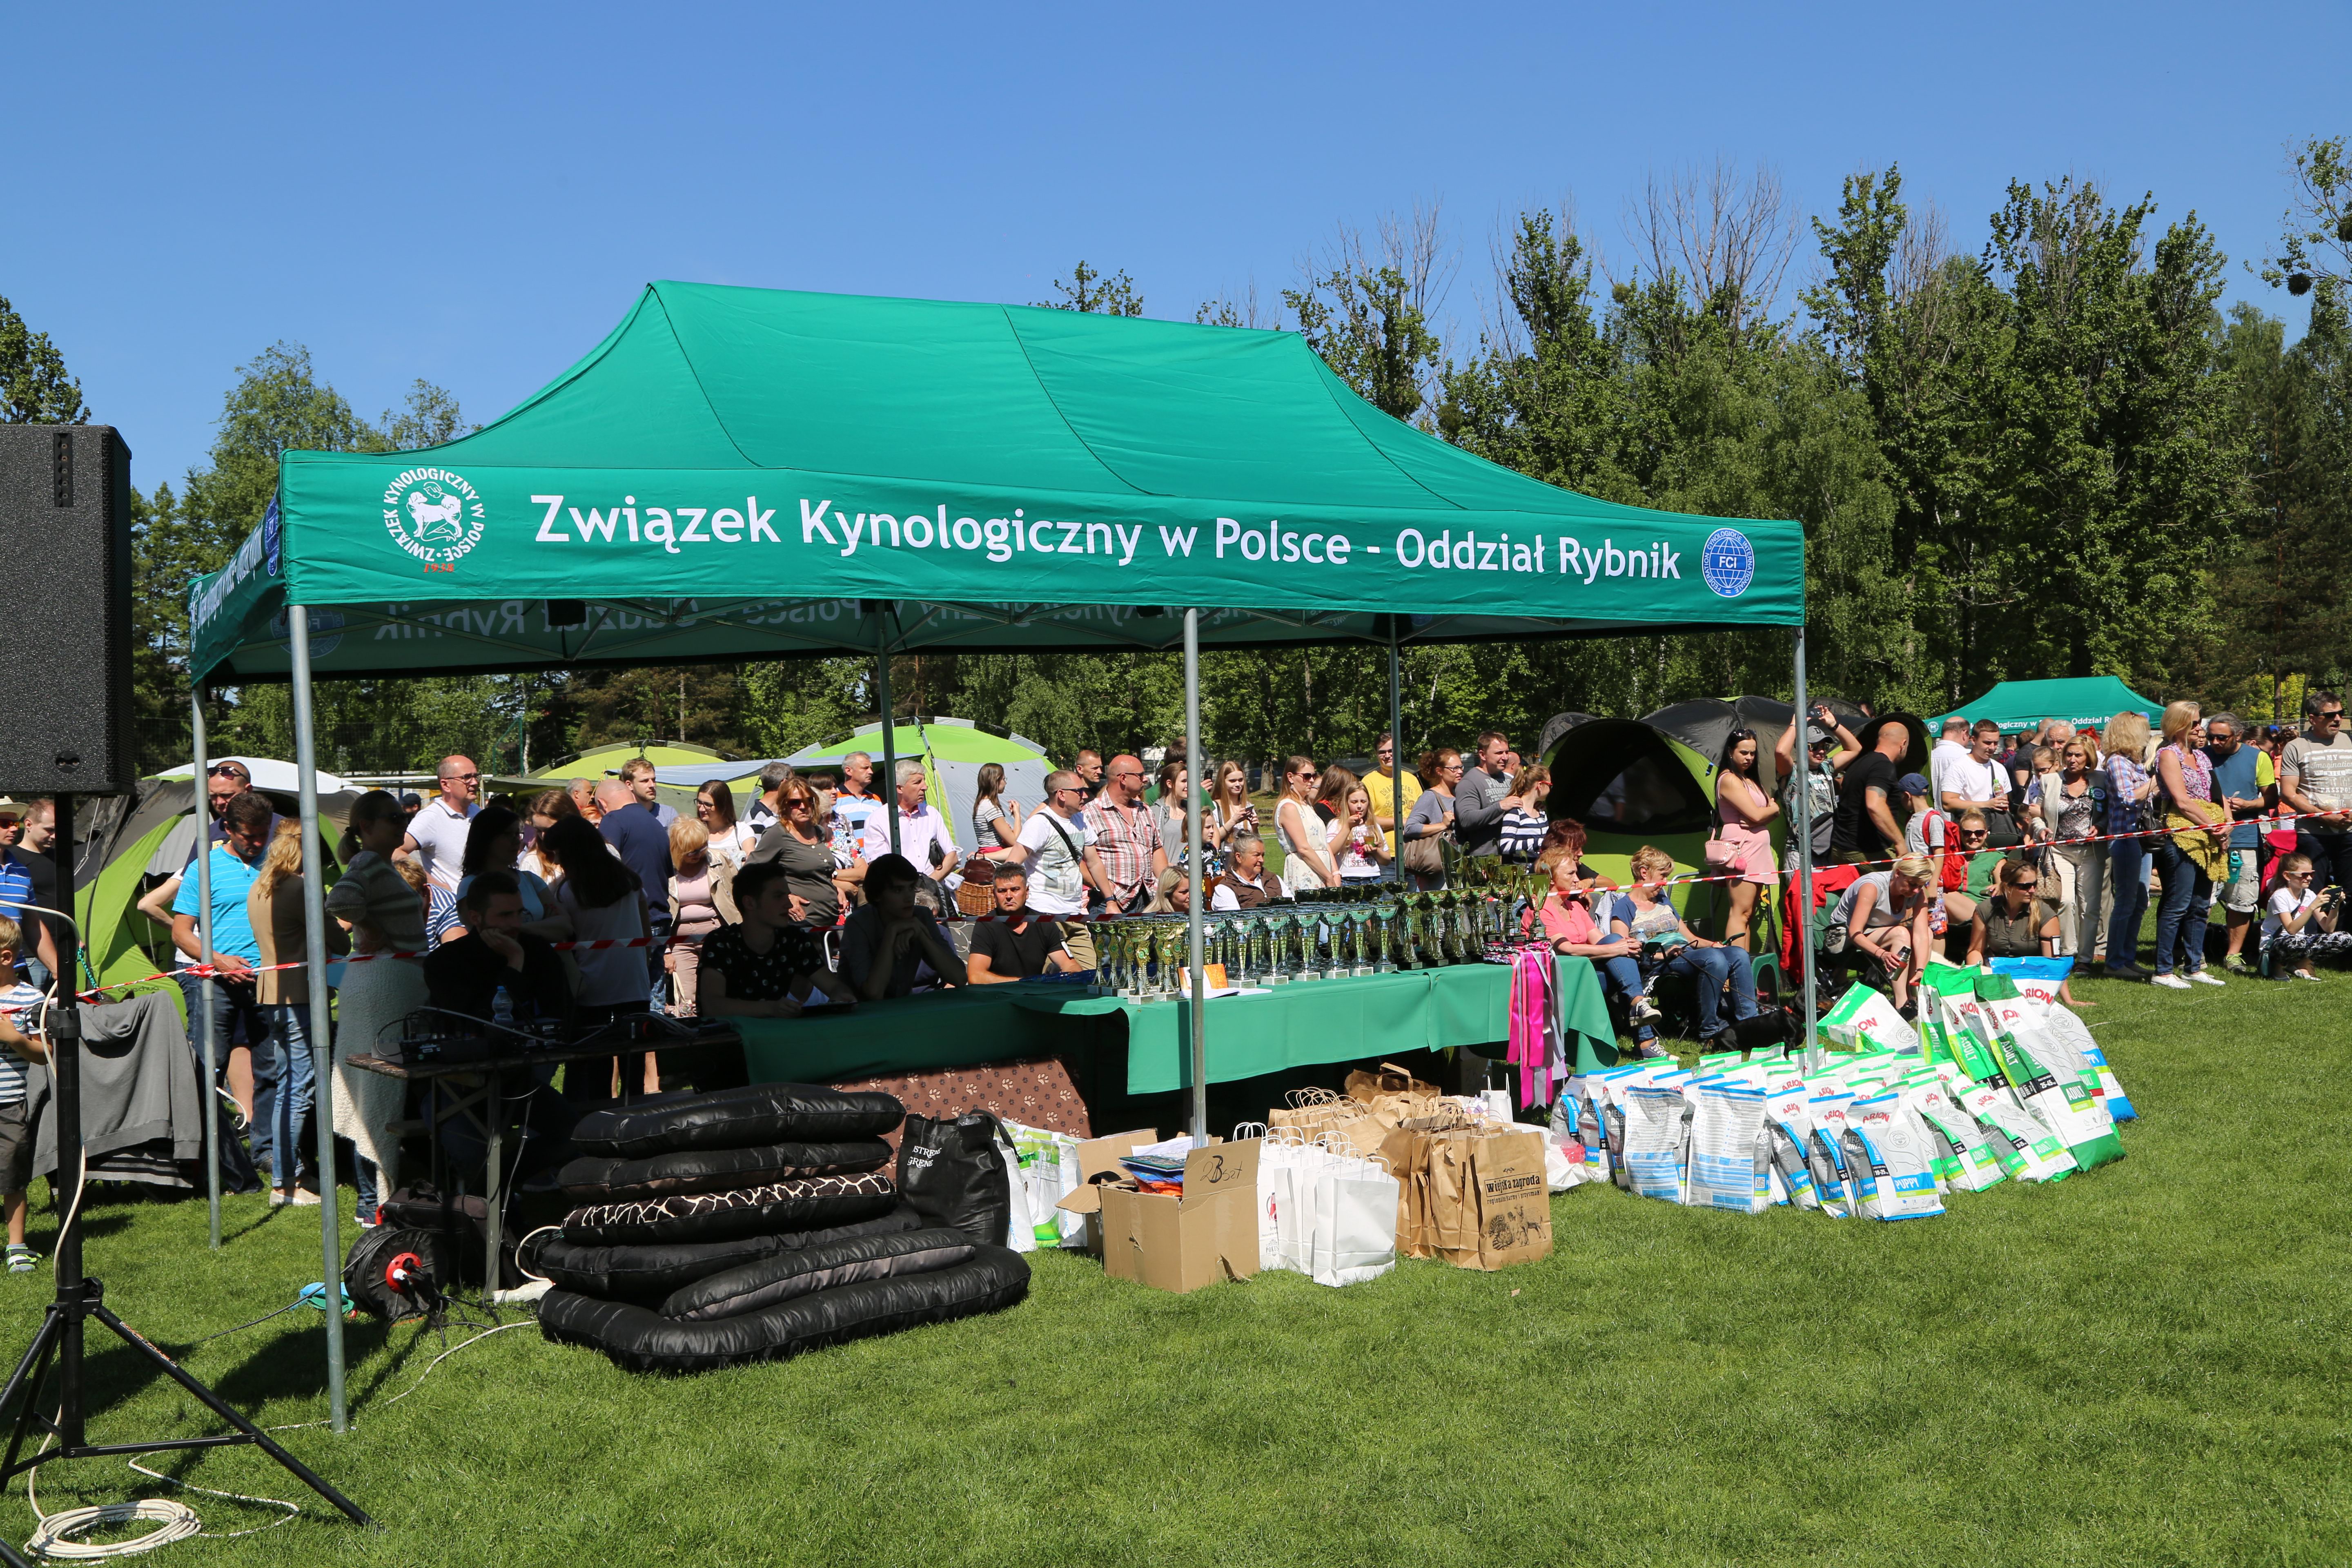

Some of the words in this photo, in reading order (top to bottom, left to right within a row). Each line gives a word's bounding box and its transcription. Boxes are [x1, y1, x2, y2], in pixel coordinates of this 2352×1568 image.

[383, 468, 479, 505] KYNOLOGICZNY
[470, 503, 485, 518] W
[442, 521, 485, 562] POLSCE
[530, 495, 782, 554] Związek
[800, 499, 1143, 566] Kynologiczny
[1158, 526, 1198, 557] w
[1216, 517, 1351, 565] Polsce
[1396, 528, 1545, 573] Oddział
[1559, 537, 1681, 585] Rybnik
[1707, 530, 1742, 550] CYNOLOGIQUE
[423, 563, 454, 573] 1938
[1719, 556, 1737, 568] FCI
[1734, 541, 1753, 593] INTERNATIONALE
[1704, 552, 1721, 592] FEDERATION
[1986, 1007, 1999, 1030] ARION
[1960, 1036, 1978, 1062] ADULT
[2001, 1040, 2019, 1066] ADULT
[1782, 1079, 1804, 1091] ARION
[1819, 1087, 1835, 1098] ARION
[2065, 1085, 2086, 1101] ADULT
[1925, 1093, 1940, 1107] ARION
[1977, 1095, 1997, 1107] ARION
[1783, 1103, 1801, 1115] ARION
[1824, 1109, 1846, 1123] ARION
[1862, 1112, 1890, 1124] ARION
[2035, 1141, 2052, 1155] ADULT
[907, 1156, 933, 1168] GRENE
[1973, 1149, 1988, 1163] ADULT
[2011, 1156, 2023, 1165] ADULT
[1948, 1160, 1960, 1169] ADULT
[1512, 1175, 1540, 1189] zagroda
[1795, 1174, 1809, 1184] PUPPY
[1863, 1182, 1877, 1190] PUPPY
[1894, 1177, 1920, 1190] PUPPY
[1520, 1189, 1542, 1200] przysmaki
